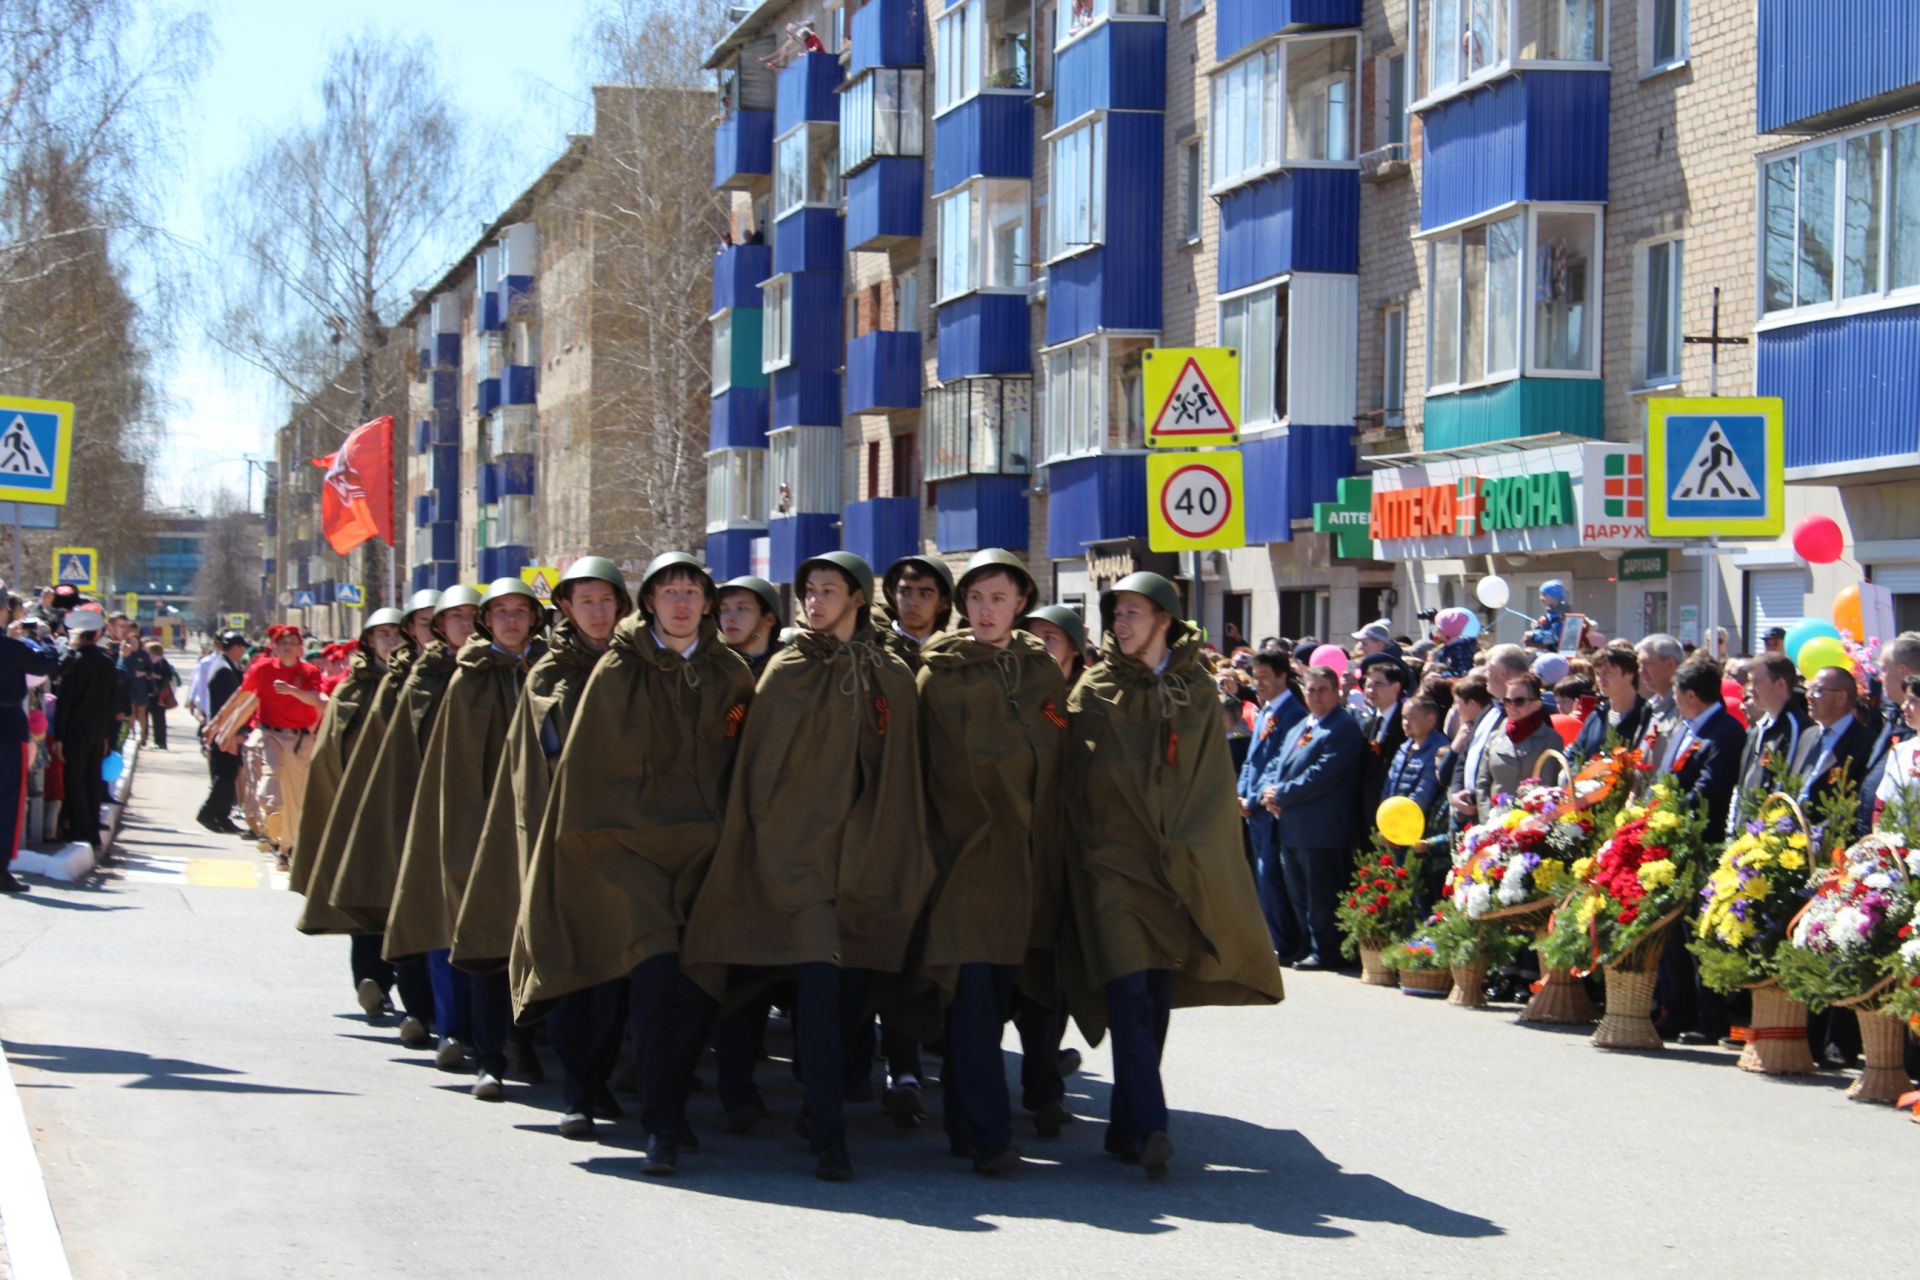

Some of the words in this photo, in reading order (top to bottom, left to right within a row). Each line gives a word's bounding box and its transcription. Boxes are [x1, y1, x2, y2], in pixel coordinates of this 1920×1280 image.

[1175, 487, 1216, 515] 40
[1369, 484, 1457, 540] АПТЕКА
[1480, 470, 1566, 532] ЭКОНА
[1328, 511, 1371, 524] АПТЕ
[1583, 524, 1645, 540] ДАРУХ
